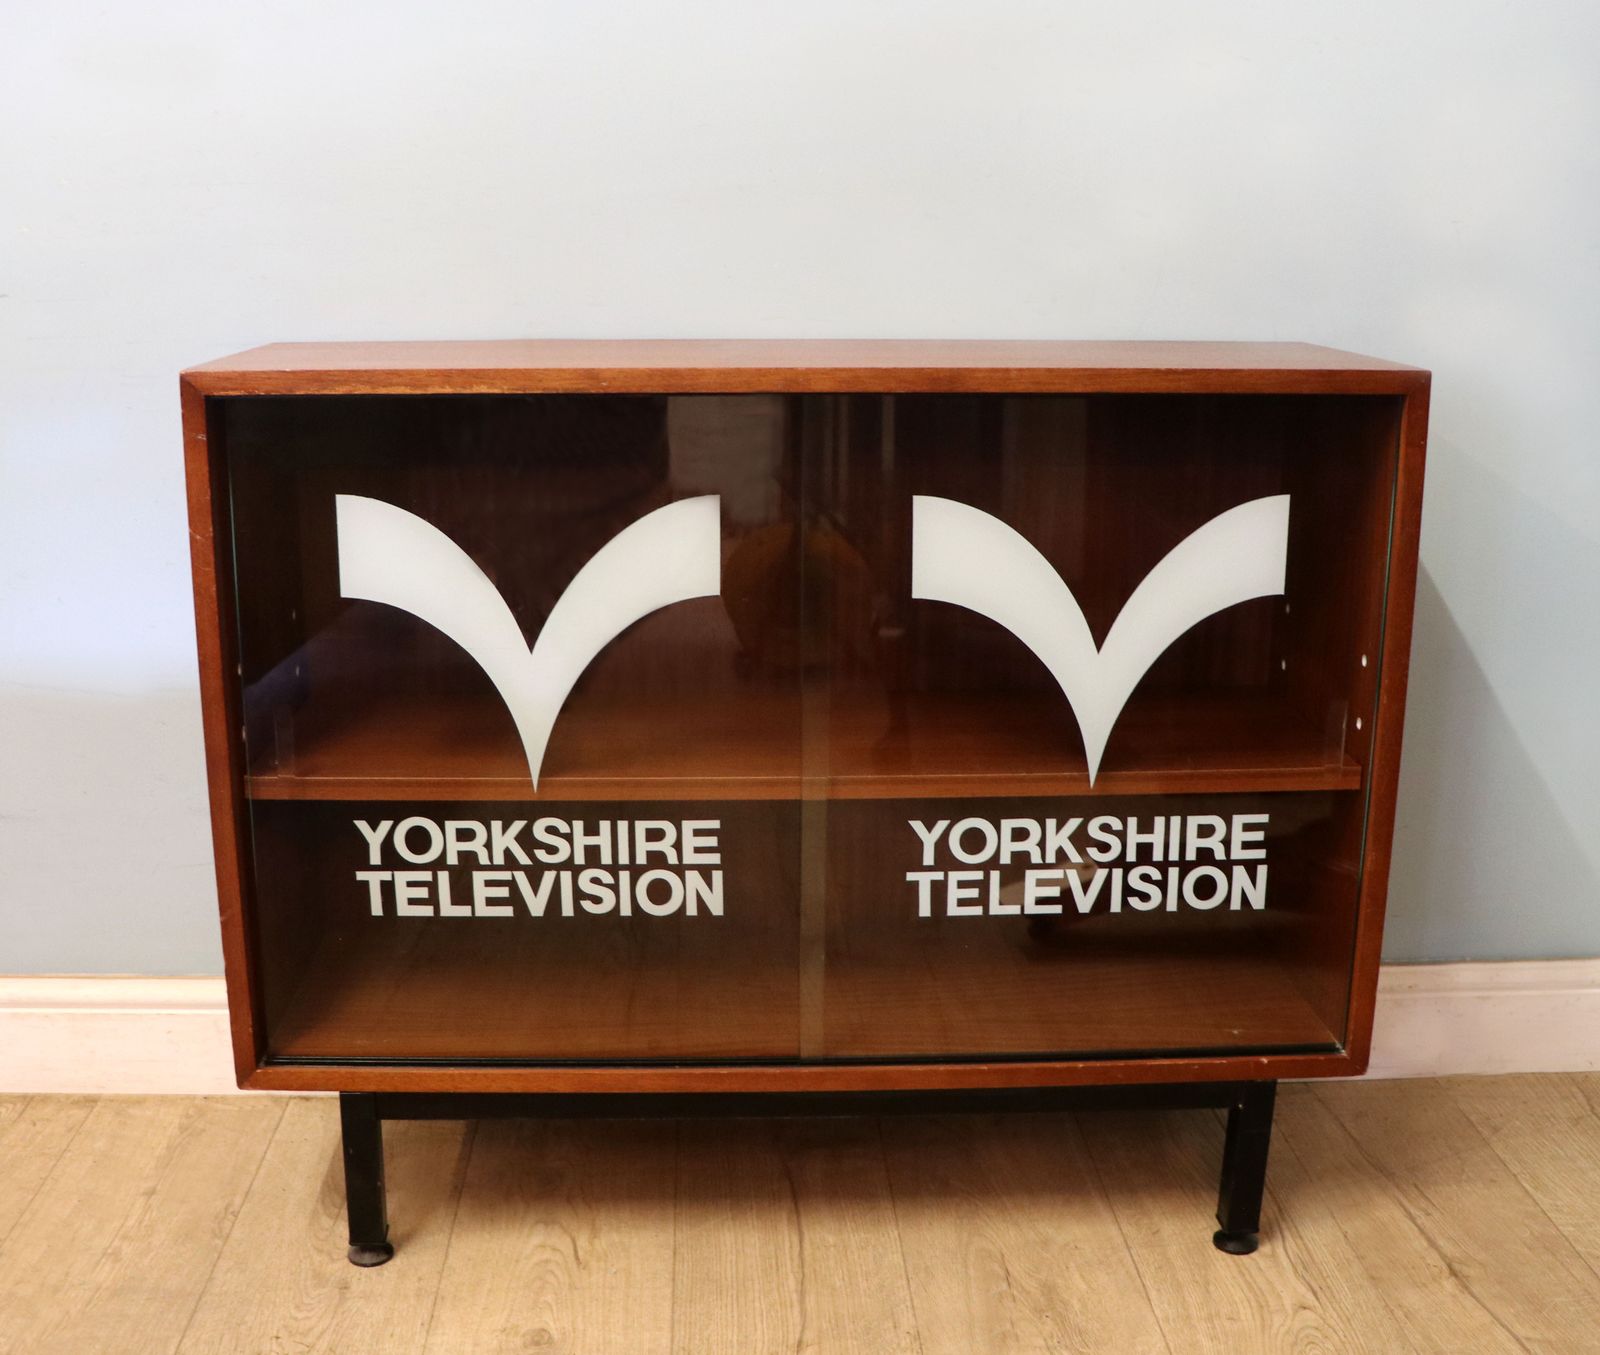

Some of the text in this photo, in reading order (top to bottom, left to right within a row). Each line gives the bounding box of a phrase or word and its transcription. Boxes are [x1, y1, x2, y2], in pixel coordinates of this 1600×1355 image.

[353, 816, 721, 866] YORKSHIRE
[907, 813, 1269, 866] YORKSHIRE
[355, 868, 725, 917] TELEVISION
[905, 864, 1269, 918] TELEVISION
